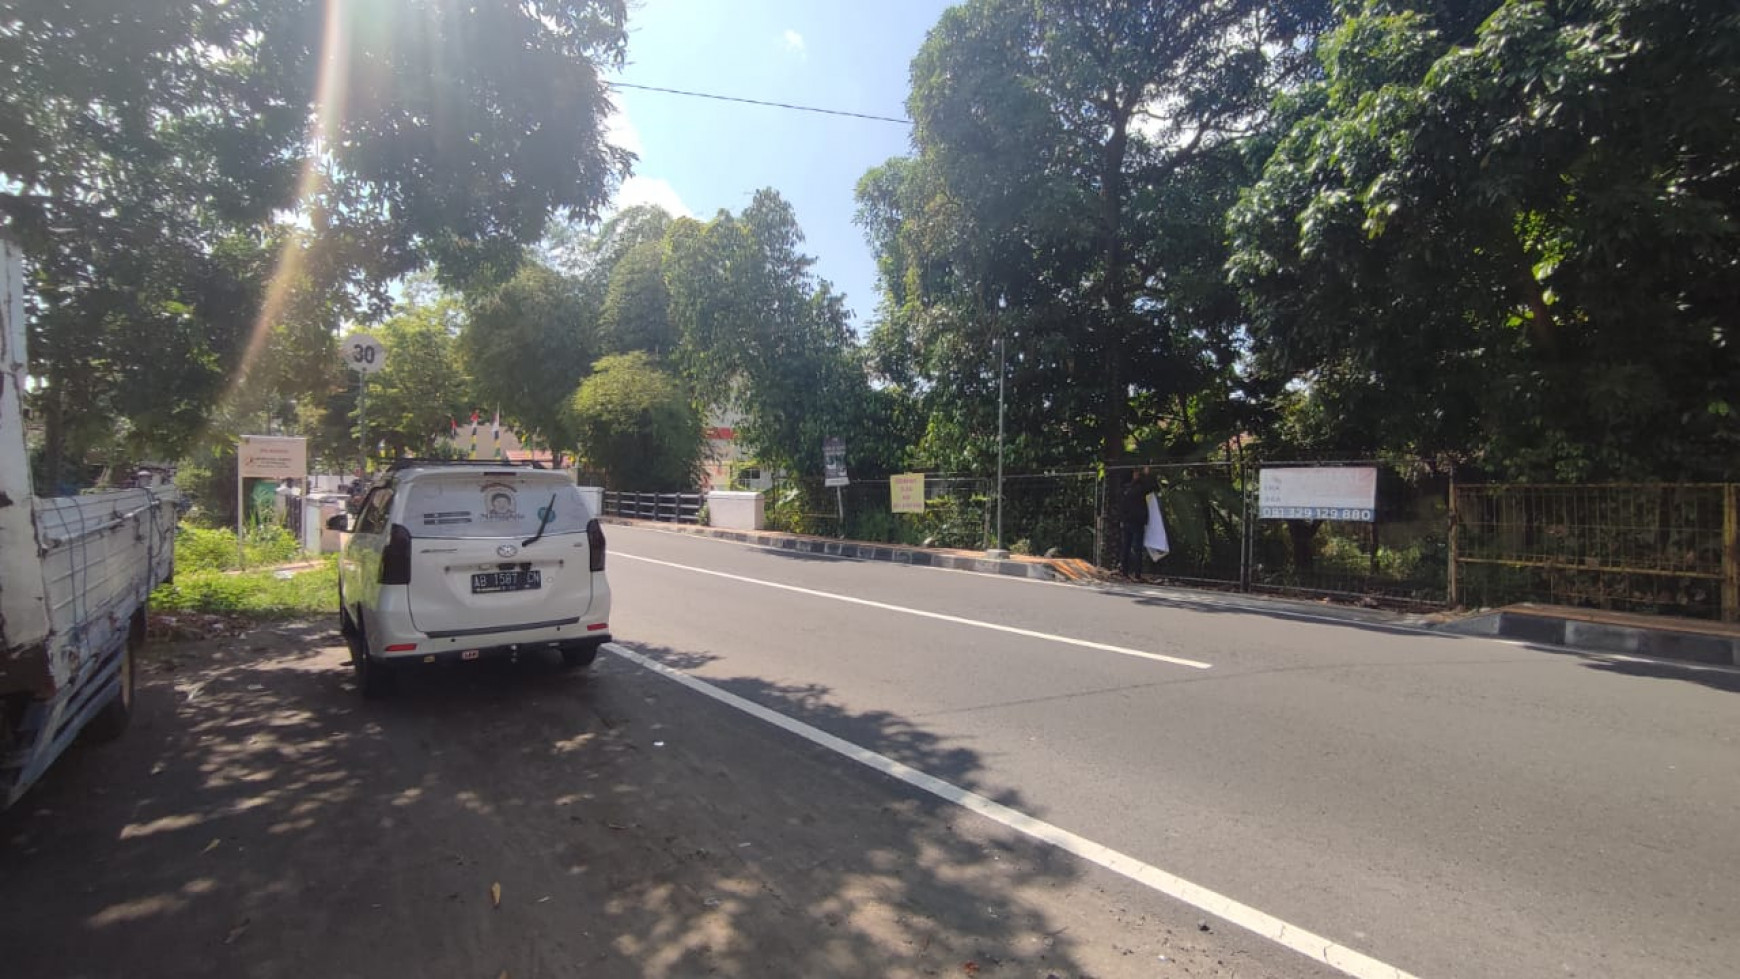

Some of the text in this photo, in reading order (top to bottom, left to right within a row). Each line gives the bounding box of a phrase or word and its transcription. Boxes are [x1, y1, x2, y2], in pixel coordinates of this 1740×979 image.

[353, 344, 375, 364] 30
[474, 575, 486, 588] AB
[495, 573, 517, 586] 1587
